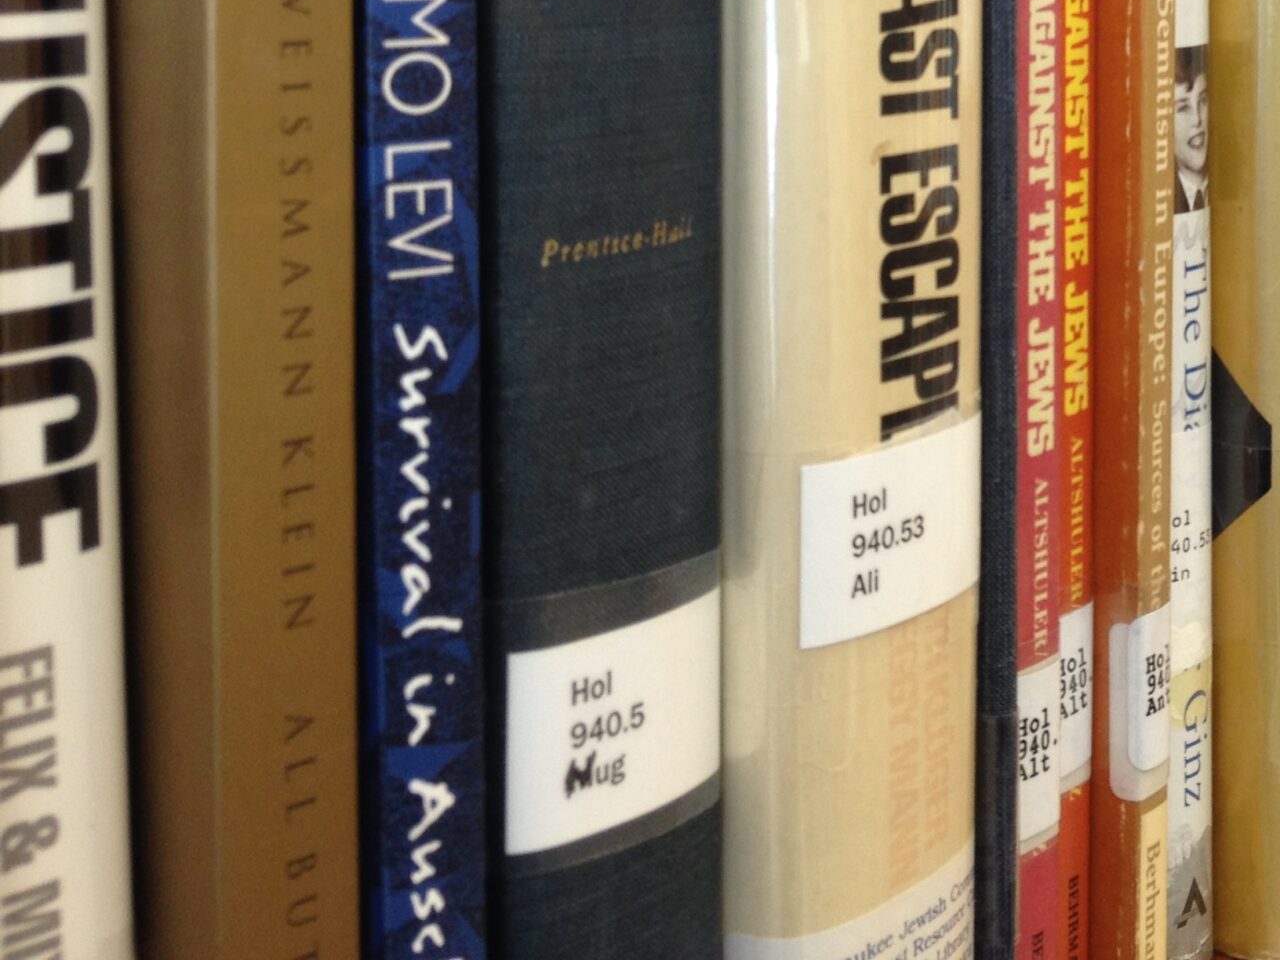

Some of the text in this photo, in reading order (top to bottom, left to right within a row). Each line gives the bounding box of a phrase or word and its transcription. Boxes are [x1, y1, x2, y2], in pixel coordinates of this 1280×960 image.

[383, 140, 455, 281] LEVI
[1028, 201, 1054, 307] THE
[1064, 168, 1089, 270] THE
[1154, 190, 1172, 227] in
[1148, 241, 1173, 385] Europe:
[1183, 247, 1208, 344] The
[1026, 317, 1054, 457] JEWS
[1063, 281, 1088, 418] JEWS
[852, 486, 887, 519] Hol
[1150, 399, 1167, 515] Sources
[278, 432, 318, 632] KLEIN
[393, 322, 463, 746] Survival in
[851, 514, 925, 558] 940.53
[851, 568, 879, 600] Ali
[1150, 523, 1167, 554] of
[570, 670, 613, 708] Hol
[570, 702, 646, 749] 940.5
[281, 712, 320, 825] ALL
[1182, 689, 1208, 808] Ginz
[0, 813, 61, 874] &
